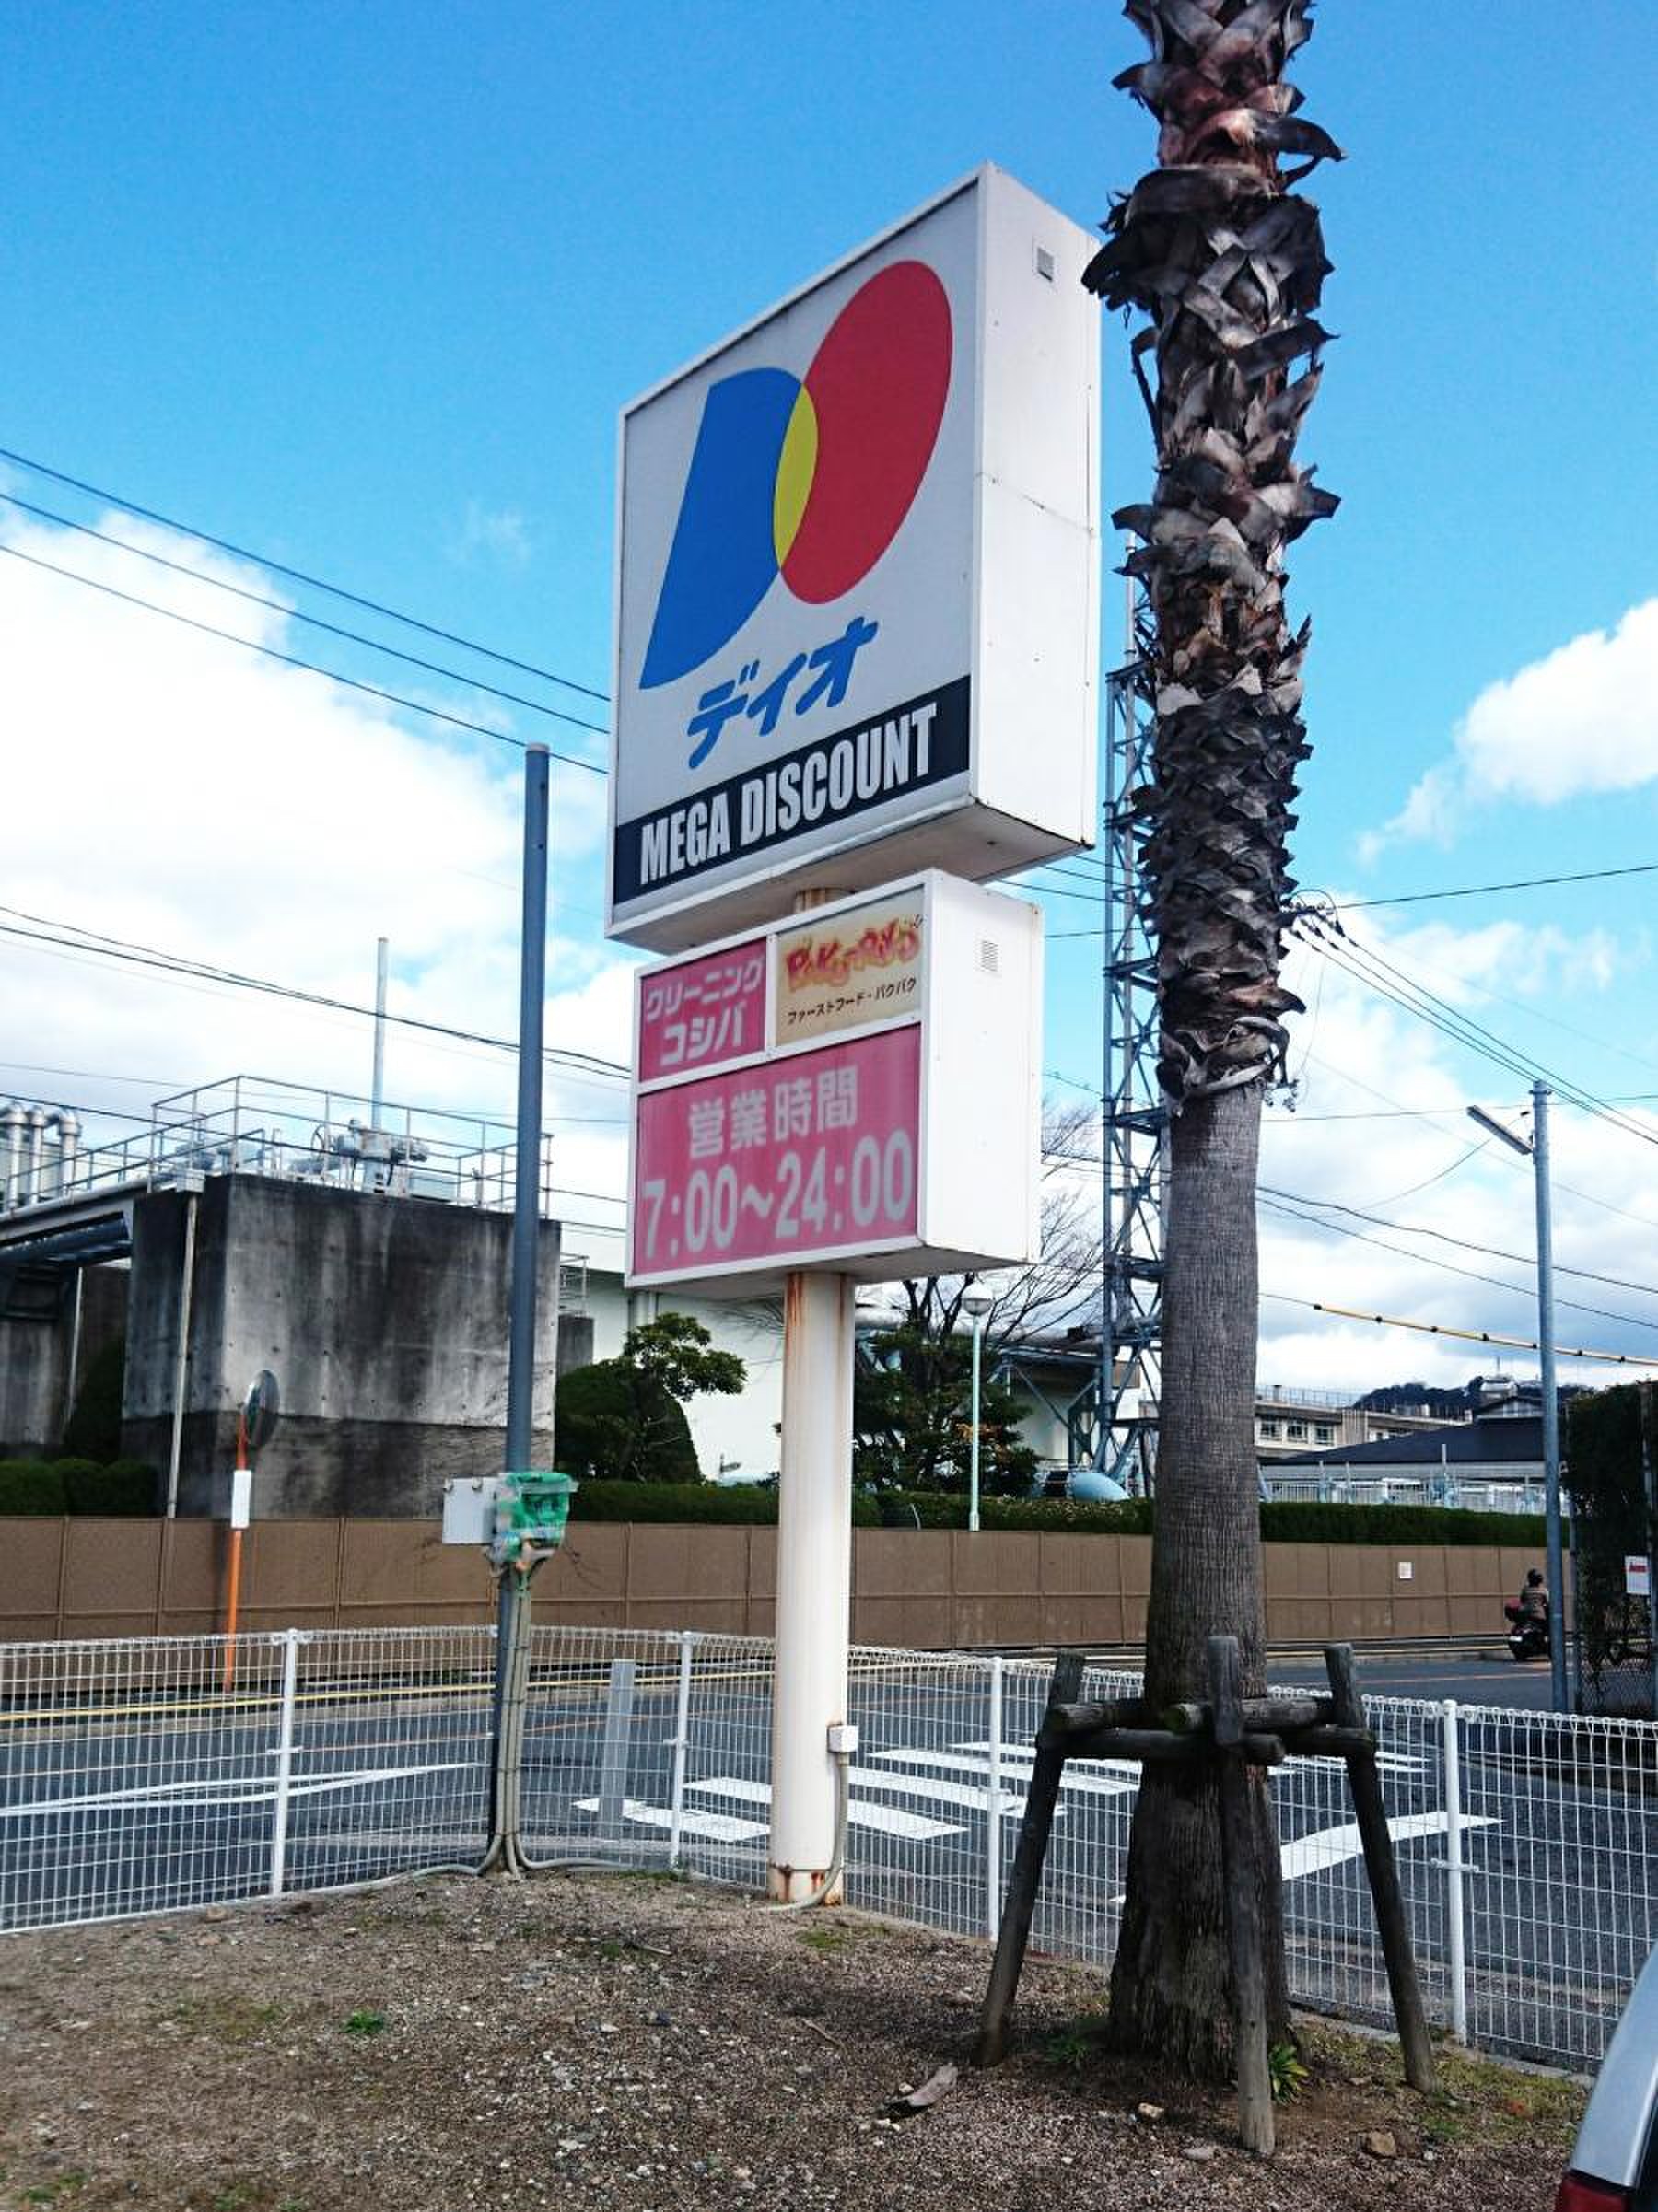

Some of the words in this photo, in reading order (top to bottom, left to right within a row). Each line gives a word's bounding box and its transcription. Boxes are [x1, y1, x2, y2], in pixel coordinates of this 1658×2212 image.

[640, 793, 730, 885] MEGA
[740, 703, 937, 846] DISCOUNT
[646, 954, 765, 1024] クリーニング
[660, 997, 746, 1068] コシバ
[688, 1065, 858, 1158] 営業時間
